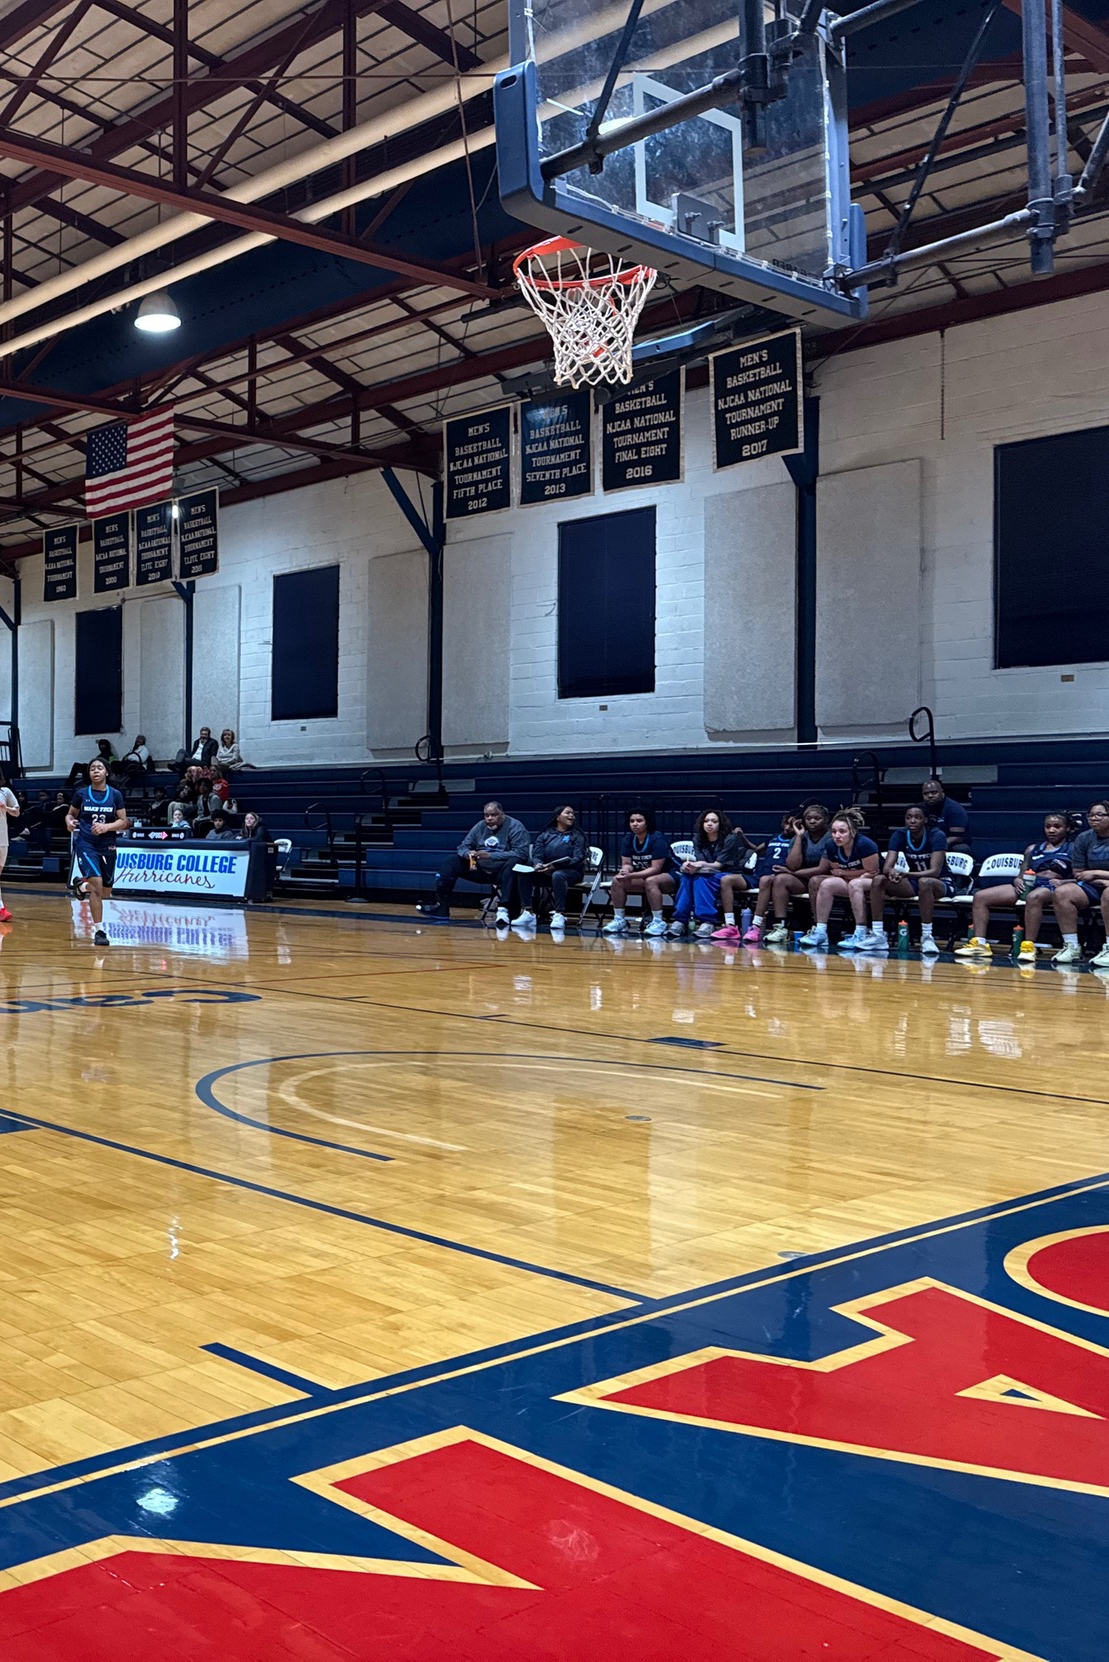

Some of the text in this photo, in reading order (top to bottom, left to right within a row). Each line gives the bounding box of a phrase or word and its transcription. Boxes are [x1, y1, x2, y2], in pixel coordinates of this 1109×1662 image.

[740, 350, 768, 368] MEN'S
[726, 362, 782, 388] BASKETBALL
[615, 394, 667, 414] BASKETBALL
[718, 380, 792, 410] NJCAA NATIONAL
[725, 398, 784, 424] TOURNAMENT
[468, 423, 490, 436] MEN'S
[530, 420, 581, 439] BASKETBALL
[606, 410, 676, 434] NJCAA NATIONAL
[730, 416, 780, 440] RUNNER-UP
[455, 438, 502, 456] BASKETBALL
[550, 434, 584, 450] NATIONAL
[614, 428, 669, 448] TOURNAMENT
[474, 448, 508, 466] NATIONAL
[616, 444, 667, 463] FINAL EIGHT
[742, 440, 768, 456] 2017
[532, 450, 581, 467] TOURNAMENT
[454, 466, 502, 484] TOURNAMENT
[526, 463, 586, 482] SEVENTH PLACE
[626, 465, 652, 479] 2016
[453, 480, 502, 499] FIFTH PLACE
[544, 483, 566, 495] 2013
[468, 498, 487, 510] 2012
[92, 814, 106, 824] 23
[772, 848, 780, 858] 2
[116, 853, 237, 874] UISBURG COLLEGE
[946, 856, 968, 870] SBURG
[113, 866, 215, 888] Hurricanes
[899, 928, 908, 936] G
